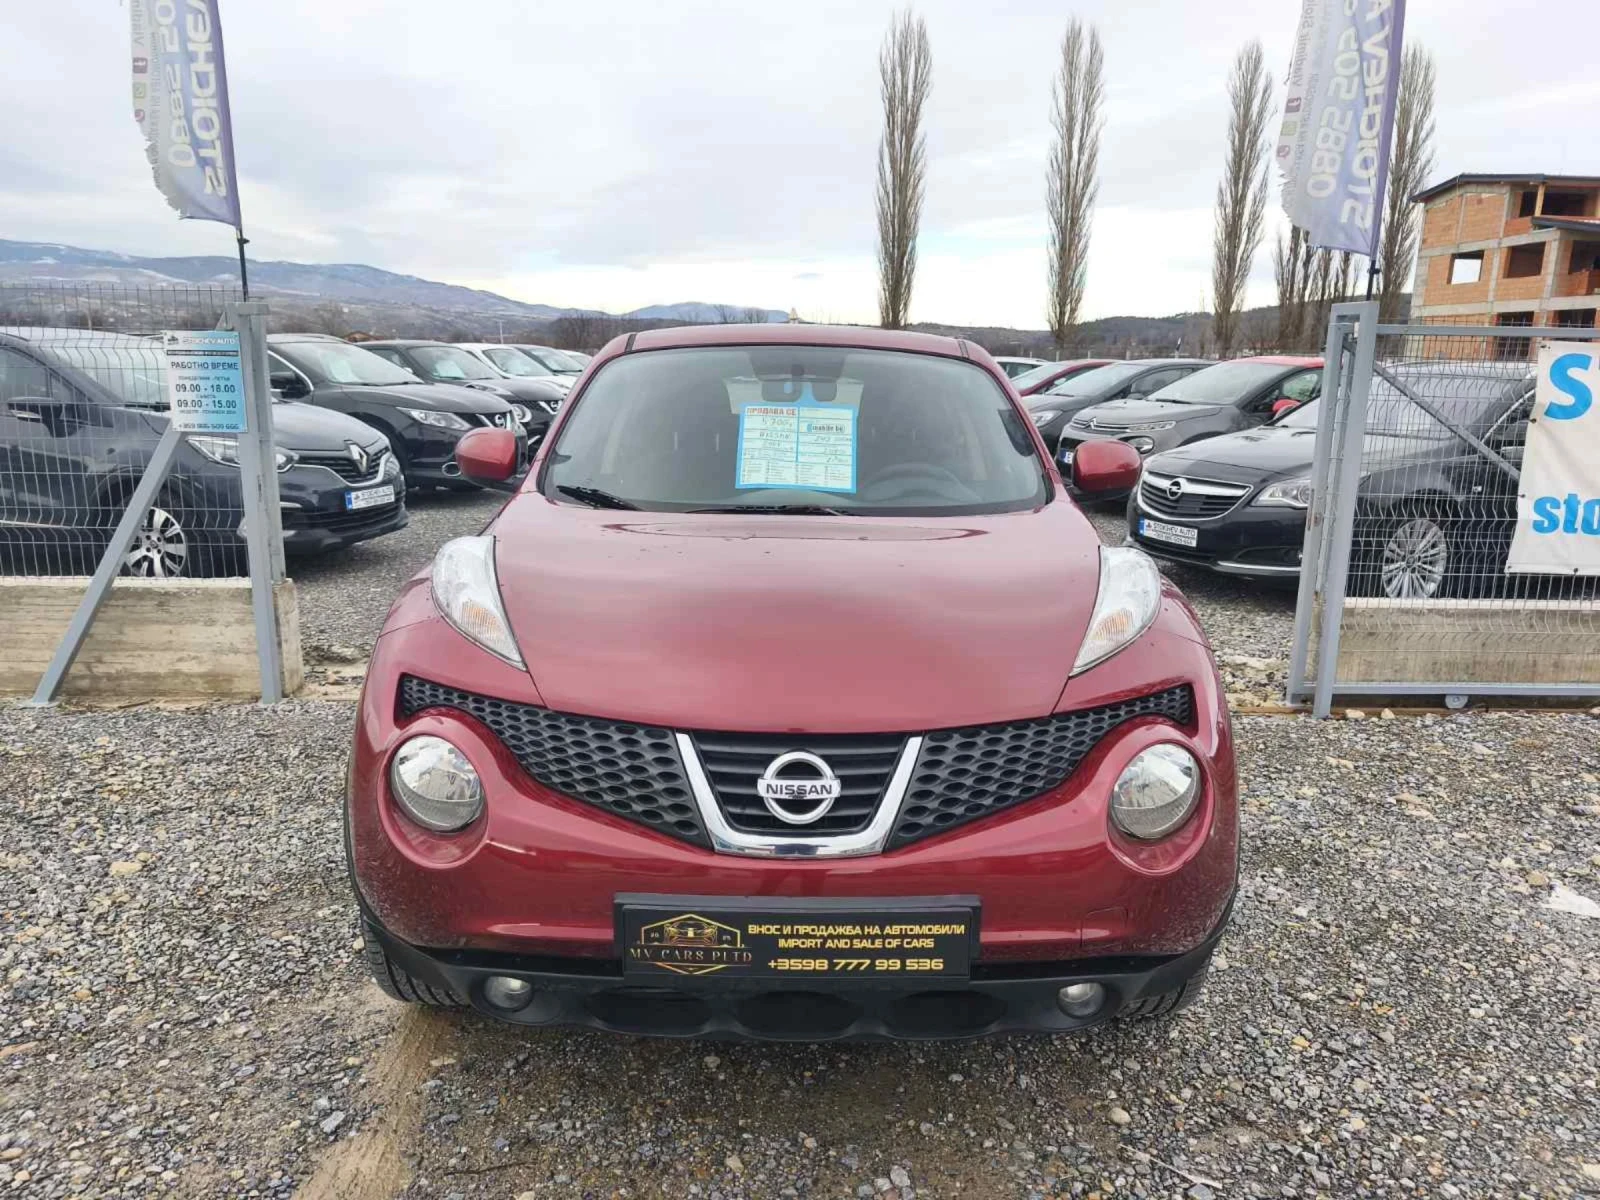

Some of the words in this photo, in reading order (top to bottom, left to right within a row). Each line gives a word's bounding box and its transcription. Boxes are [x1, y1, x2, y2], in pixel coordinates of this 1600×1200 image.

[171, 361, 209, 369] РАБОТНО
[211, 362, 239, 370] ВРЕМЕ
[176, 384, 201, 393] 09.00
[210, 384, 236, 393] 18.00
[177, 400, 203, 408] 09.00
[213, 400, 237, 409] 15.00
[766, 783, 832, 795] NISSAN
[748, 924, 781, 935] ВНОС
[783, 924, 792, 934] И
[793, 924, 862, 937] ПРОДАЖБА
[864, 925, 881, 935] НА
[883, 924, 965, 935] АВТОМОБИЛИ
[778, 938, 823, 948] IMPORT
[825, 938, 850, 948] AND
[852, 938, 883, 948] SALE
[885, 938, 902, 948] OF
[903, 938, 935, 948] CARS
[629, 947, 653, 960] MV
[661, 949, 704, 961] CARS
[768, 958, 829, 970] +3598
[833, 959, 871, 970] 777
[875, 959, 901, 970] 99
[905, 958, 944, 970] 536
